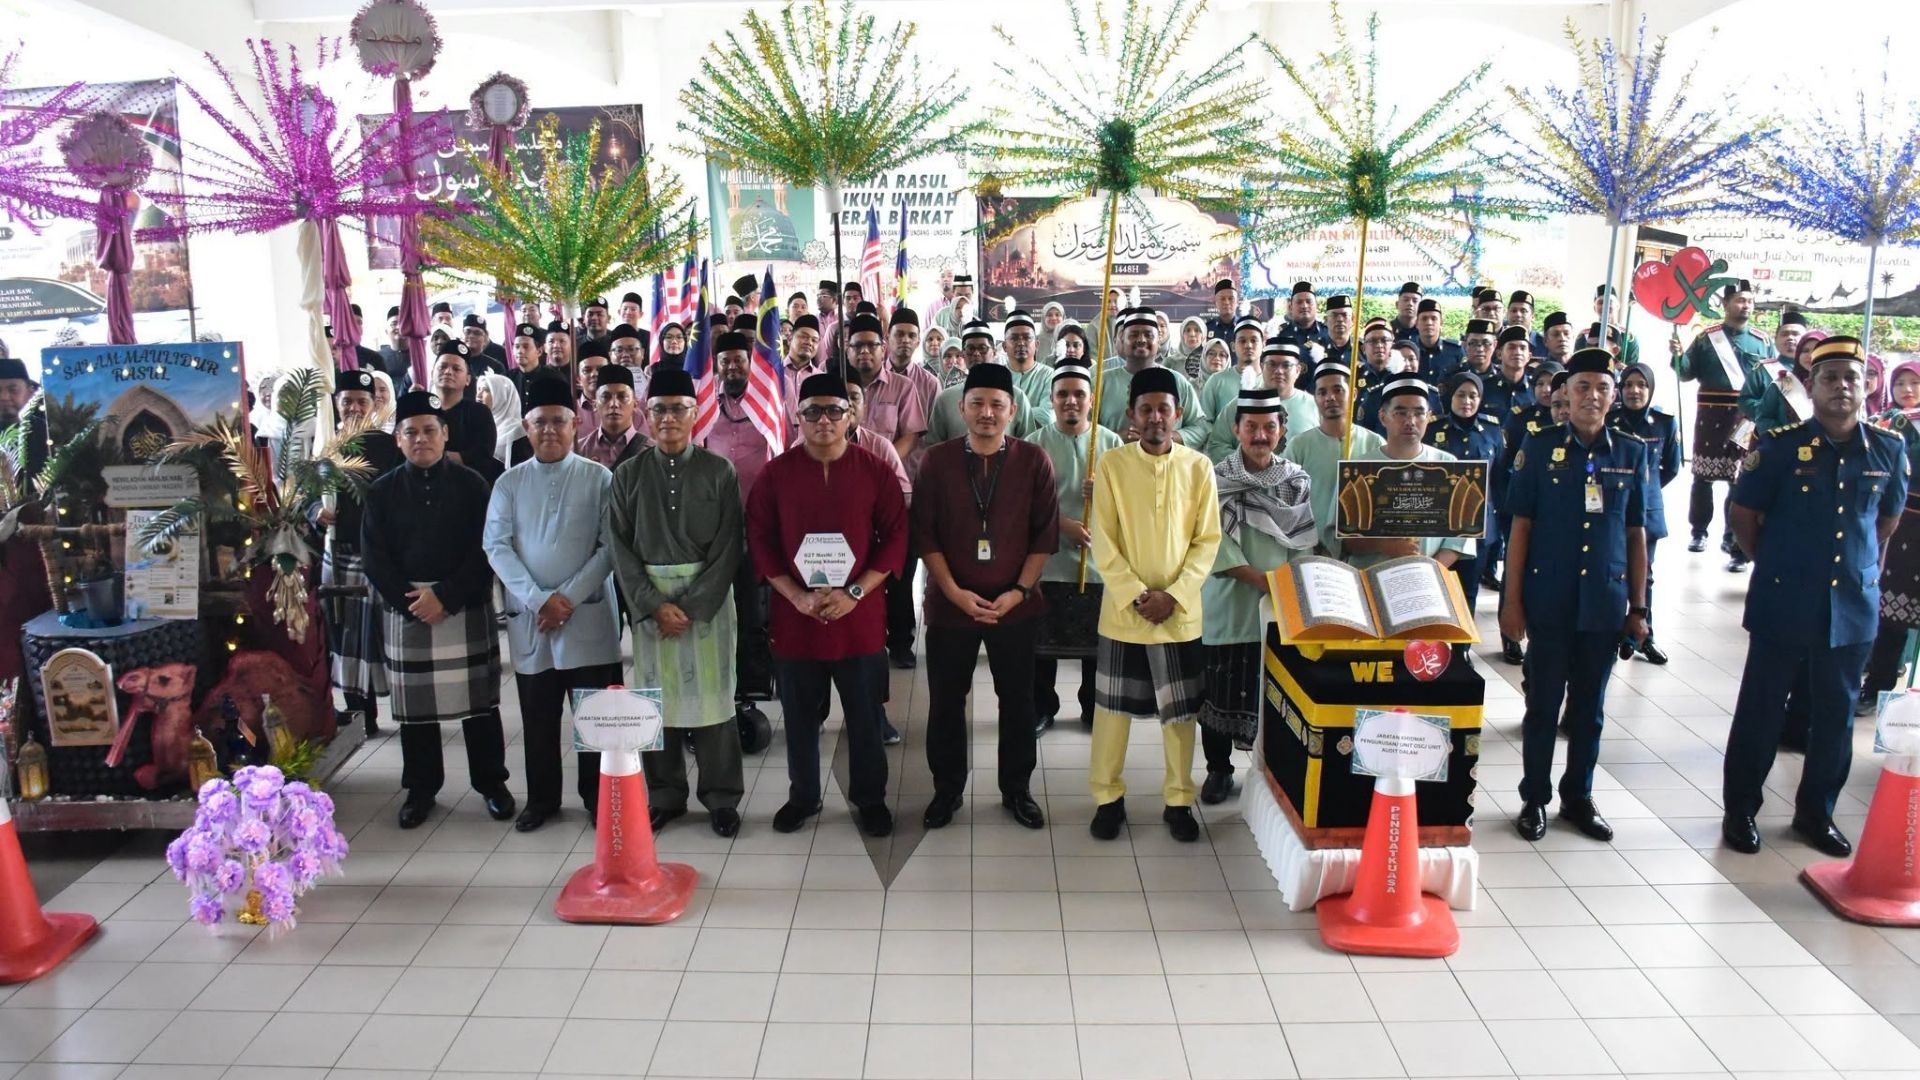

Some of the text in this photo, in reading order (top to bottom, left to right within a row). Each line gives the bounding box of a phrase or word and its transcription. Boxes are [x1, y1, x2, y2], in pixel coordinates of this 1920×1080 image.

[896, 174, 948, 188] RASUL
[891, 193, 957, 206] UMMAH
[889, 210, 953, 225] BRKAT
[1114, 264, 1139, 274] 1448H
[1637, 265, 1659, 280] WE
[1753, 269, 1770, 279] JP
[124, 349, 220, 377] MAULIDUR
[111, 366, 171, 383] RASUL
[1350, 661, 1394, 683] WE
[1376, 733, 1400, 741] JABATAN
[611, 778, 623, 857] PENGUATKUASA
[1387, 806, 1400, 893] PENGUATKUASA
